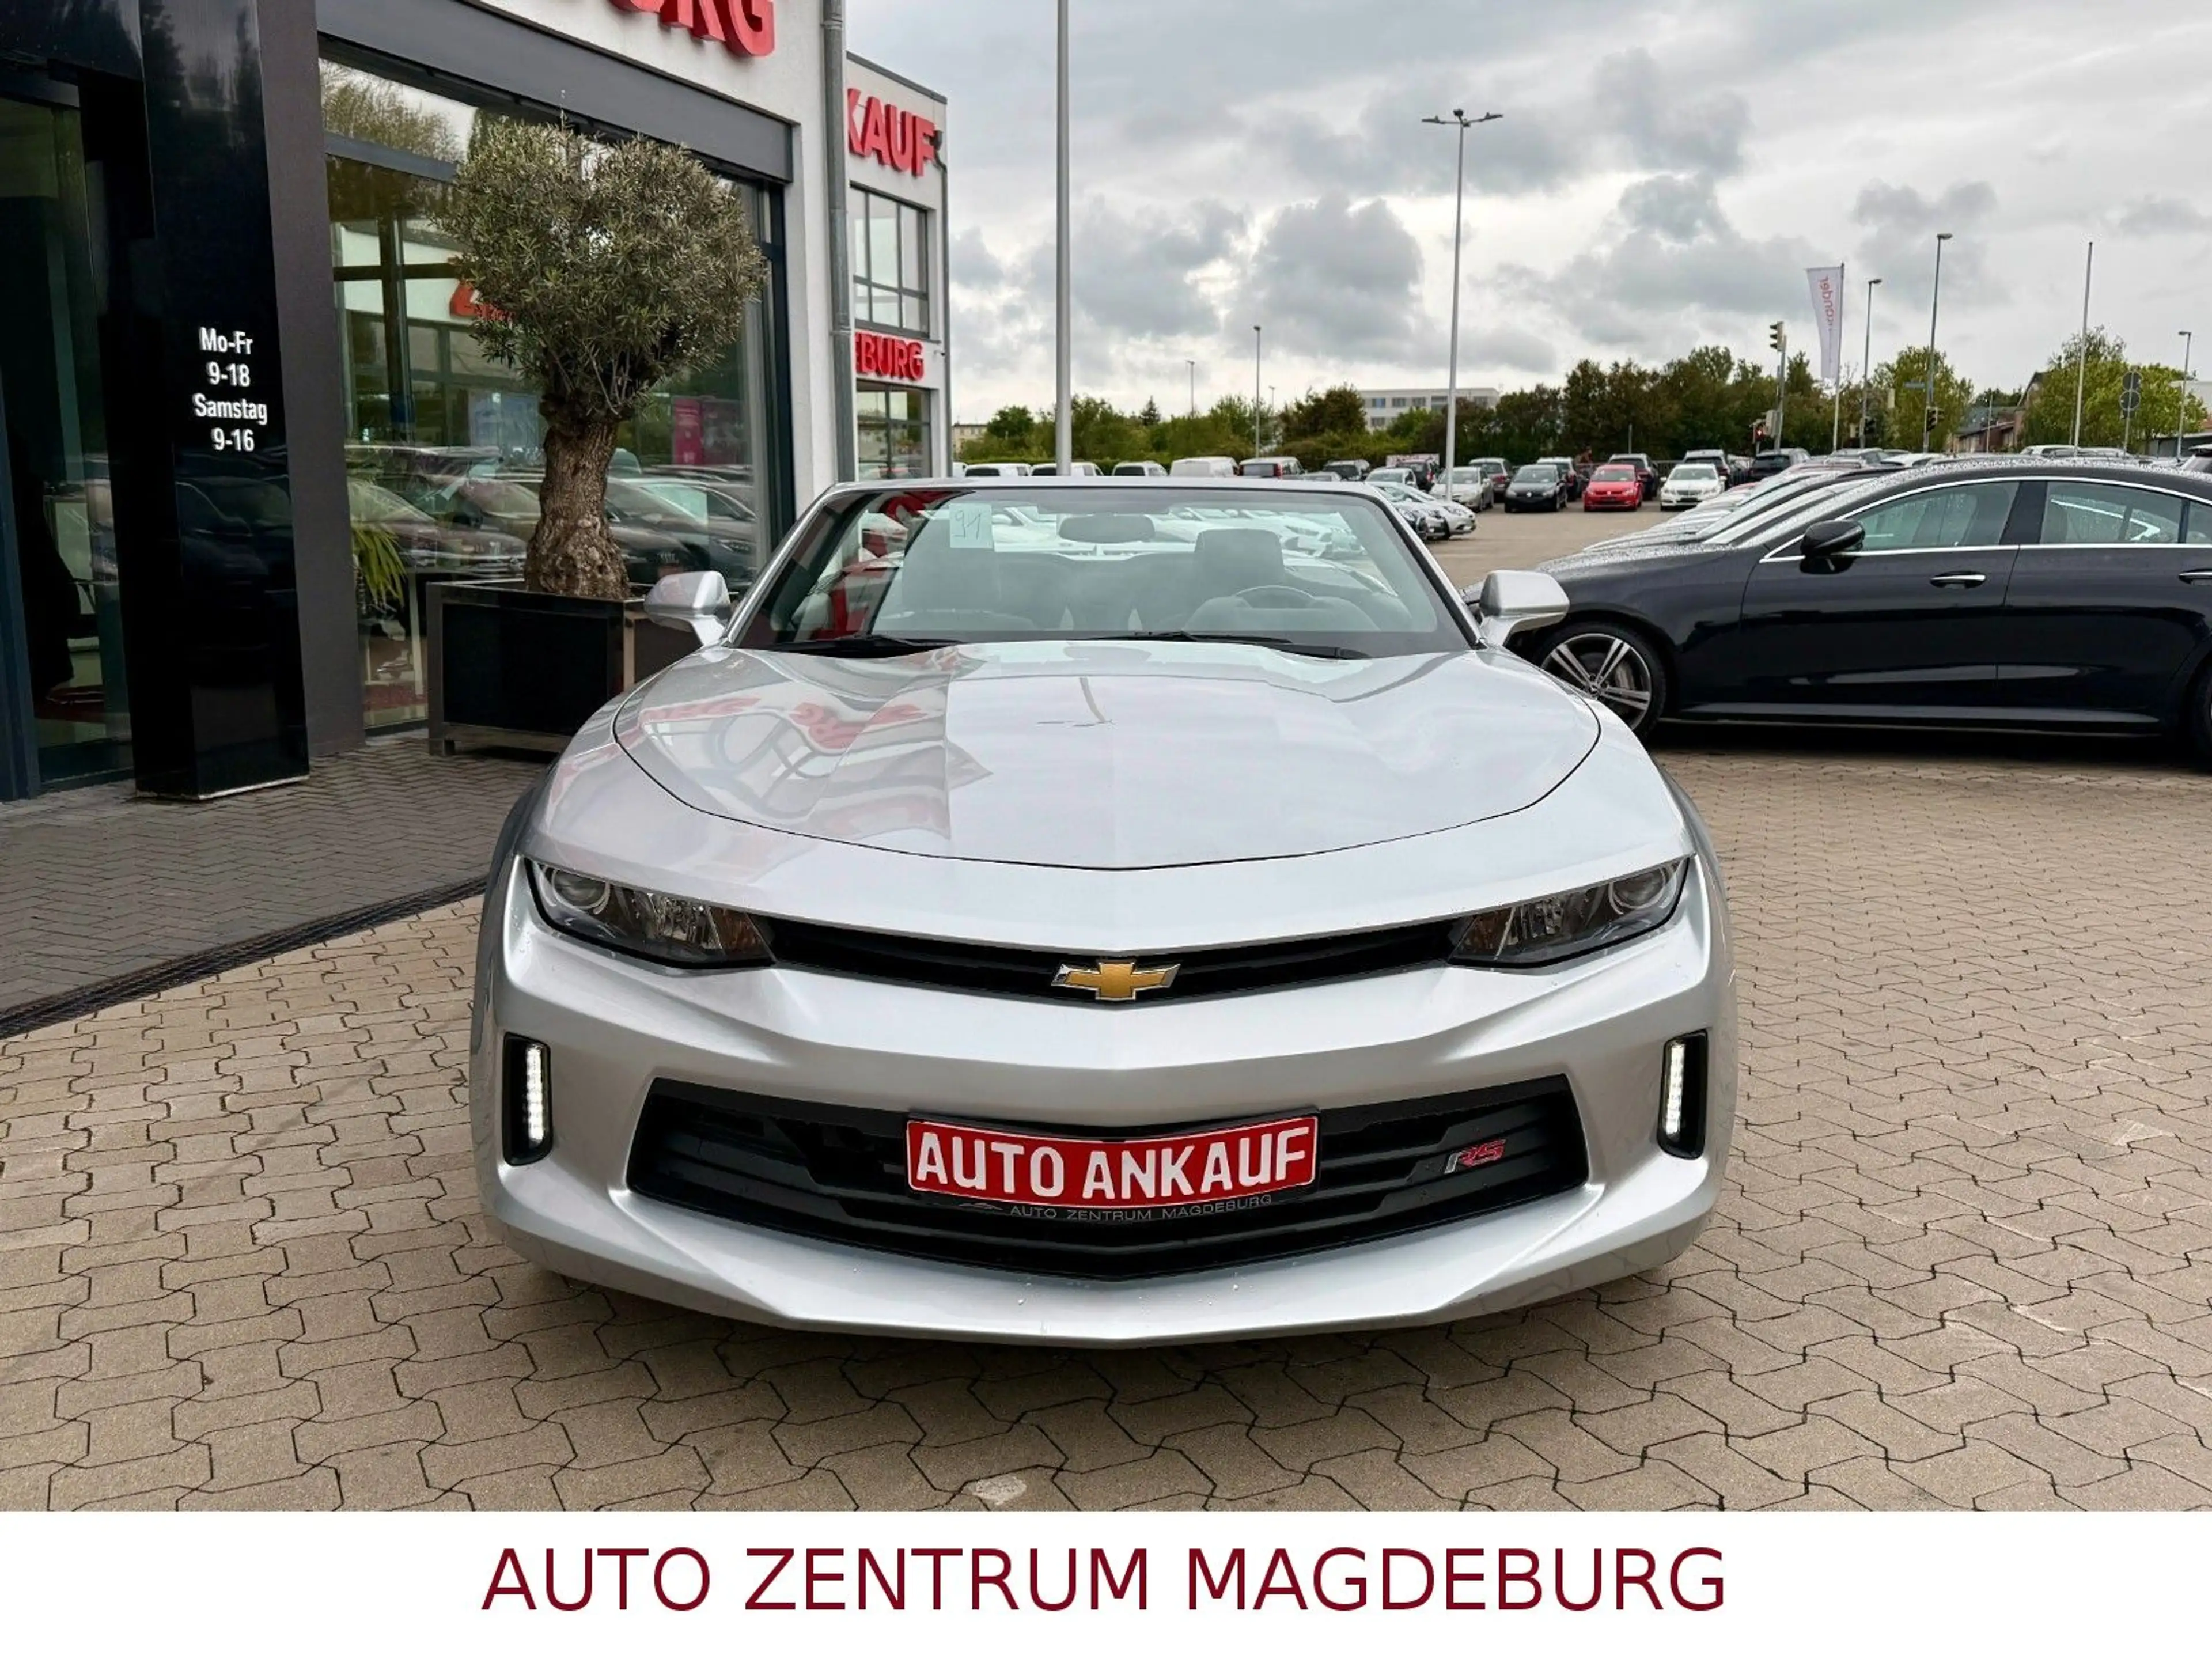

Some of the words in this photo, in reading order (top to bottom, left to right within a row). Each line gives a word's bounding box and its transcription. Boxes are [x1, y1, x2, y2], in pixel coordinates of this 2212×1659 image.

[199, 327, 253, 354] Mo-Fr
[206, 361, 251, 387] 9-18
[192, 393, 268, 425] Samstag
[211, 427, 255, 452] 9-16
[916, 1132, 1065, 1197] AUTO
[1082, 1127, 1309, 1200] ANKAUF
[1010, 1205, 1058, 1219] AUTO
[1067, 1209, 1152, 1222] ZENTRUM
[1162, 1194, 1272, 1219] MAGDEBURG
